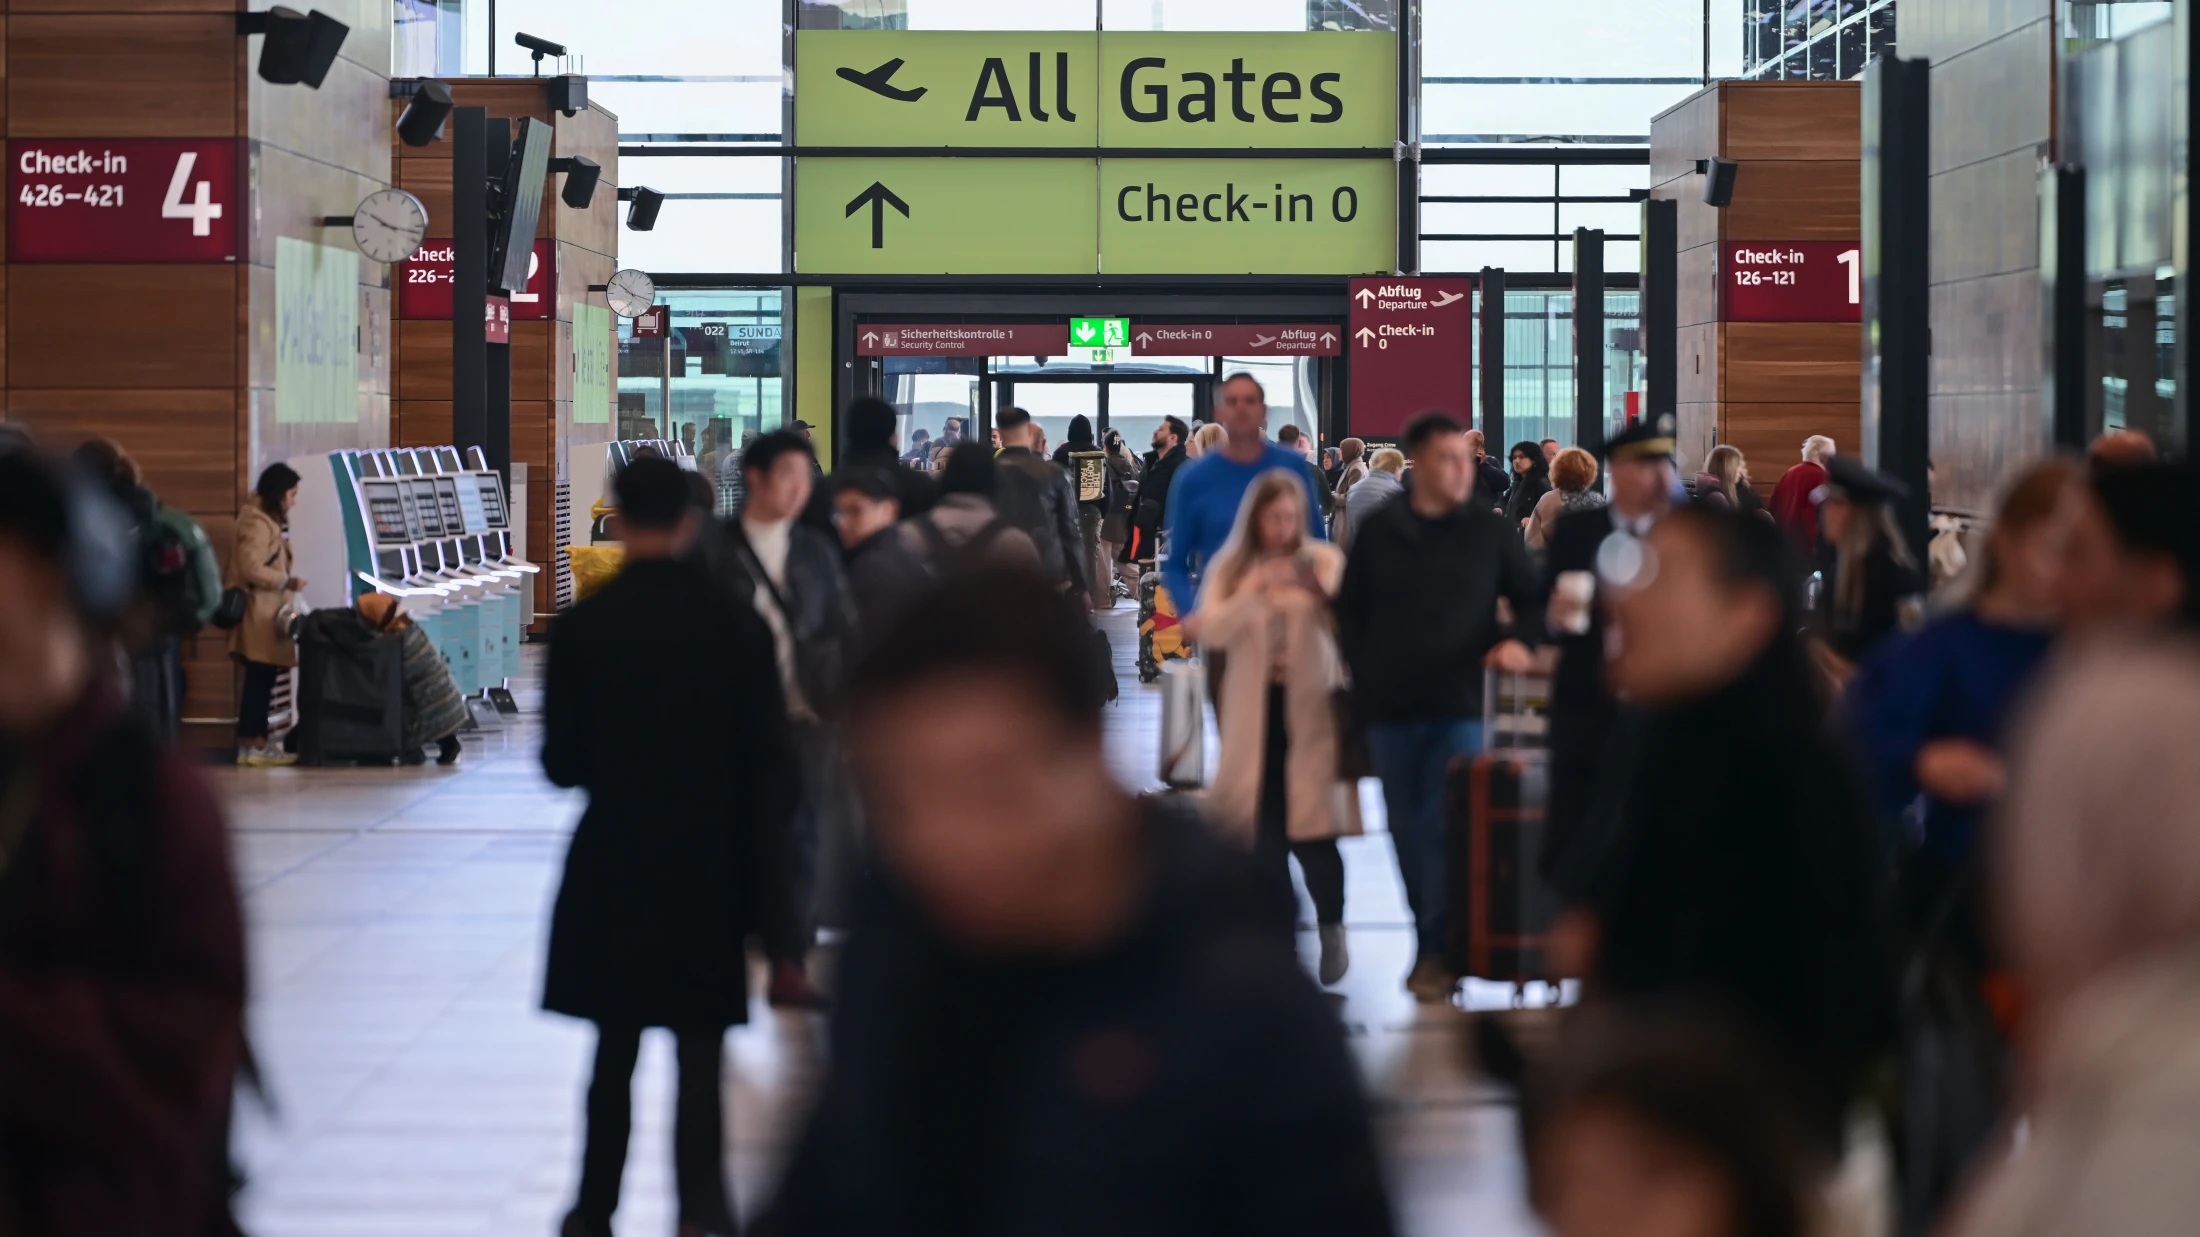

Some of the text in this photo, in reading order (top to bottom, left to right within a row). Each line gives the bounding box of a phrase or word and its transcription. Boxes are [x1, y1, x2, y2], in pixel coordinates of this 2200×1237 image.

[965, 52, 1344, 123] All Gates
[20, 149, 128, 174] Check-in
[162, 152, 222, 236] 4
[1117, 183, 1358, 222] Check-in 0
[1735, 249, 1804, 264] Check-in
[1836, 249, 1860, 304] 1
[1378, 285, 1421, 300] Abflug
[1378, 300, 1428, 311] Departure
[704, 326, 725, 336] 022
[900, 329, 1013, 339] Sicherheitskontrolle 1
[1156, 329, 1212, 339] Check-in 0
[1281, 329, 1316, 341] Abflug
[1379, 324, 1434, 336] Check-in
[900, 341, 965, 350] Security Control
[1276, 341, 1316, 350] Departure
[1379, 338, 1387, 350] 0
[1087, 460, 1095, 488] NORTH
